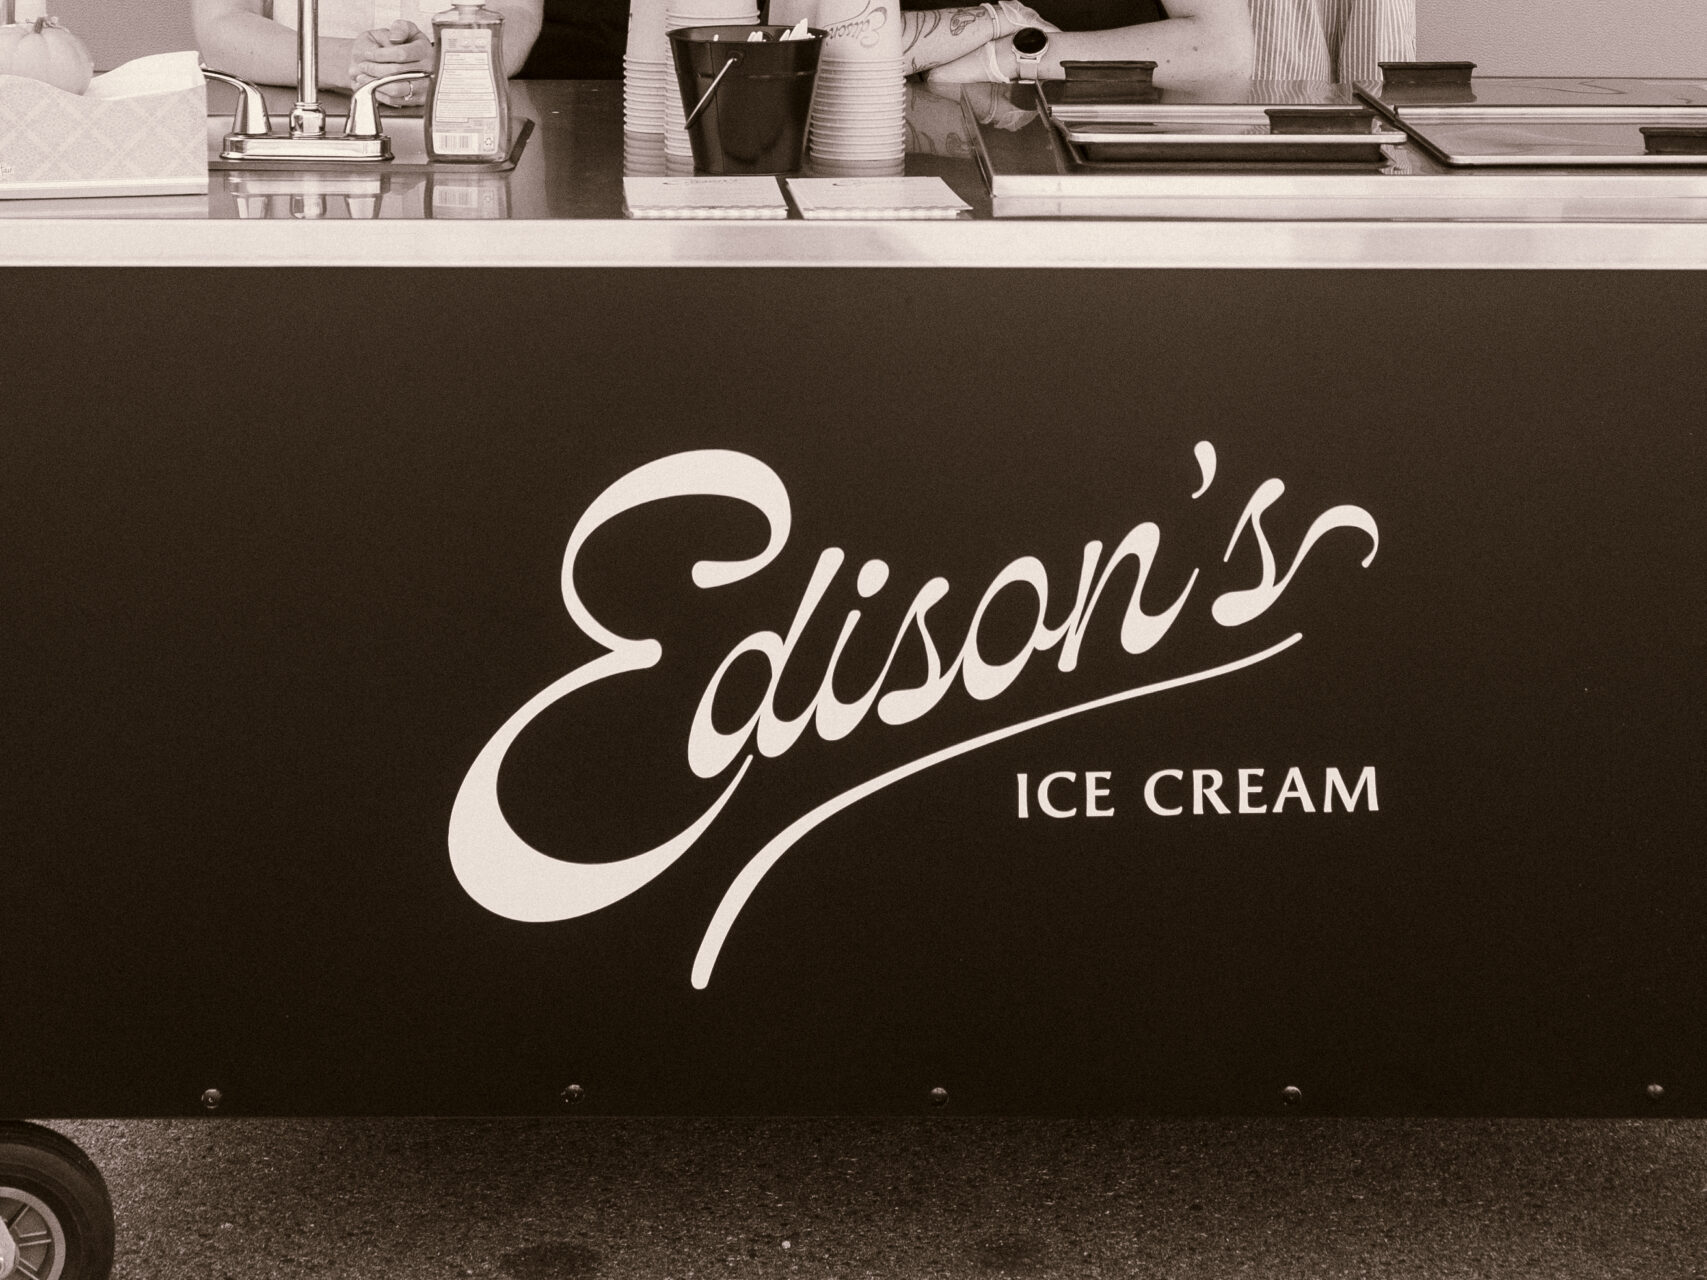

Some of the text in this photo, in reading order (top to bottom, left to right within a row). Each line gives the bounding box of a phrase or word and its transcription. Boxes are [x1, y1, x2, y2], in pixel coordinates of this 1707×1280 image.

[447, 440, 1380, 924] Edison's
[1016, 766, 1379, 819] ICE CREAM
